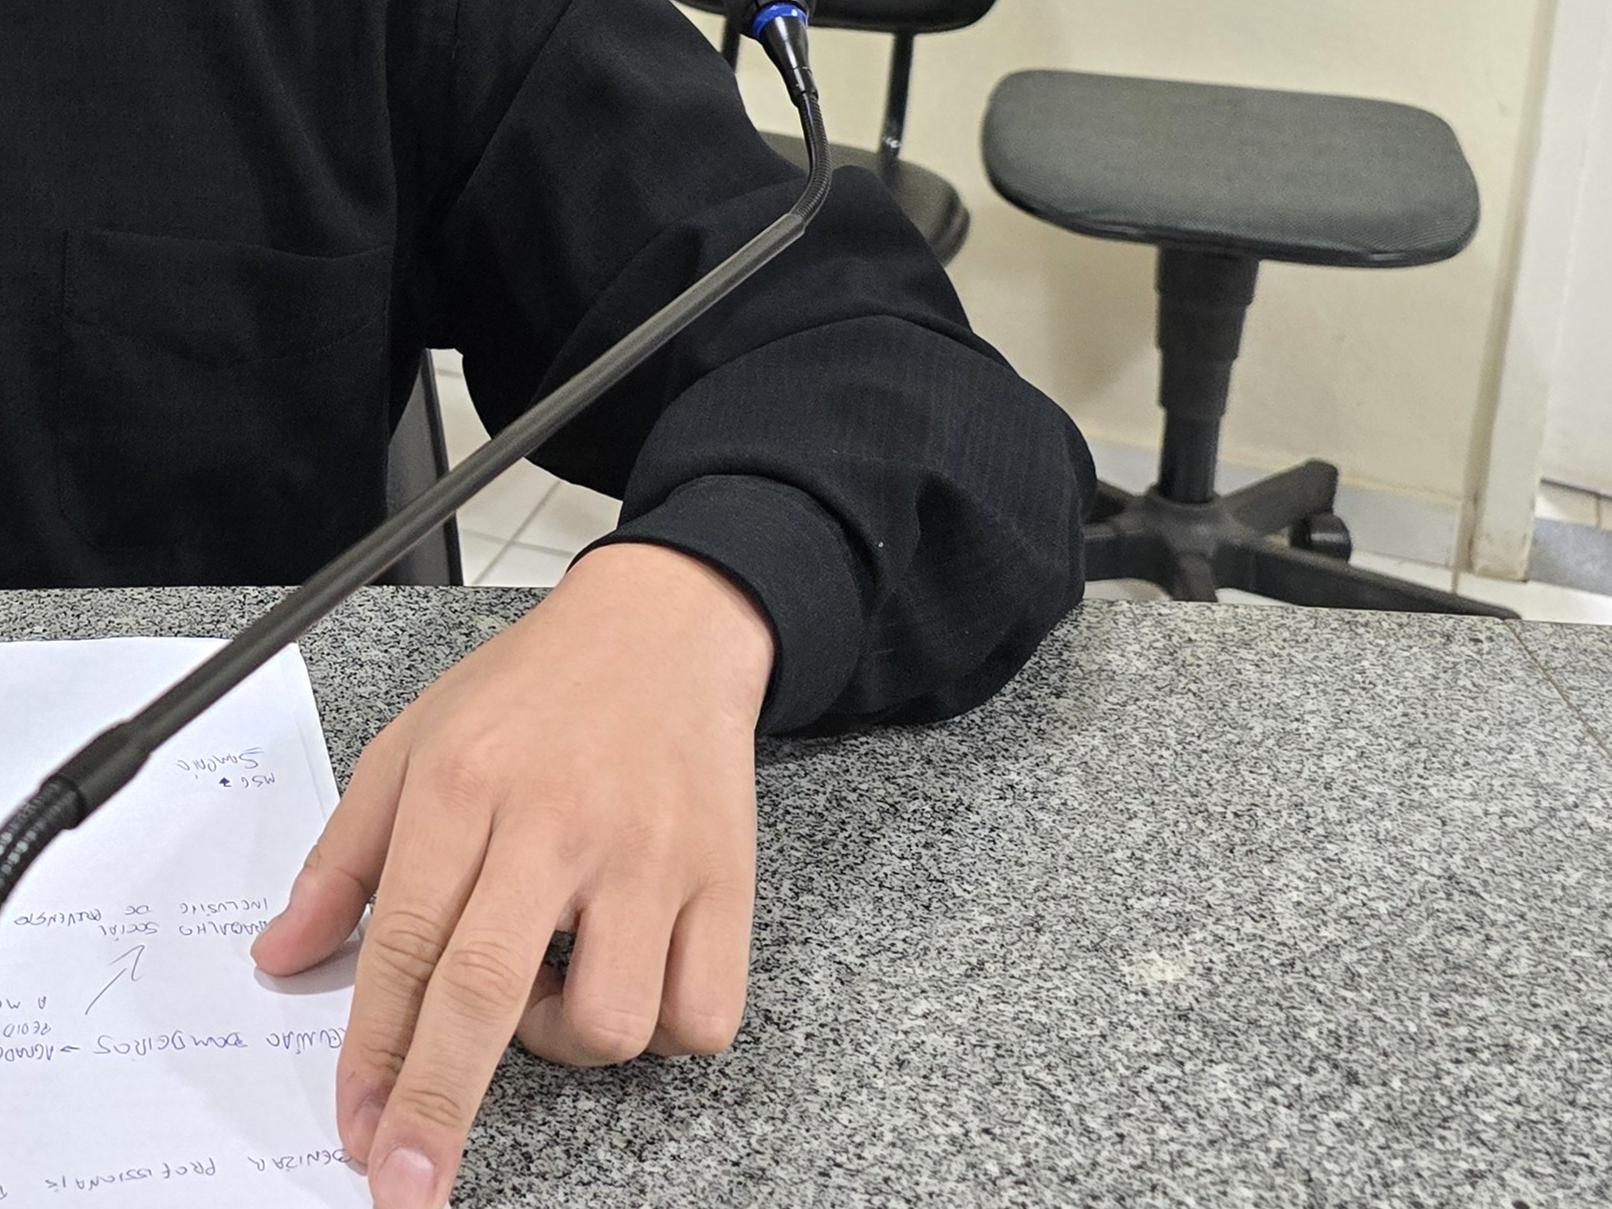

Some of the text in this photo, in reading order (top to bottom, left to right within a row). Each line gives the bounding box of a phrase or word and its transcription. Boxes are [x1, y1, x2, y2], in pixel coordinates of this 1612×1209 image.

[124, 904, 149, 915] DE
[98, 920, 267, 942] RABALHO SOCIAL
[38, 996, 47, 1010] A
[265, 1027, 347, 1055] EUNIÃO
